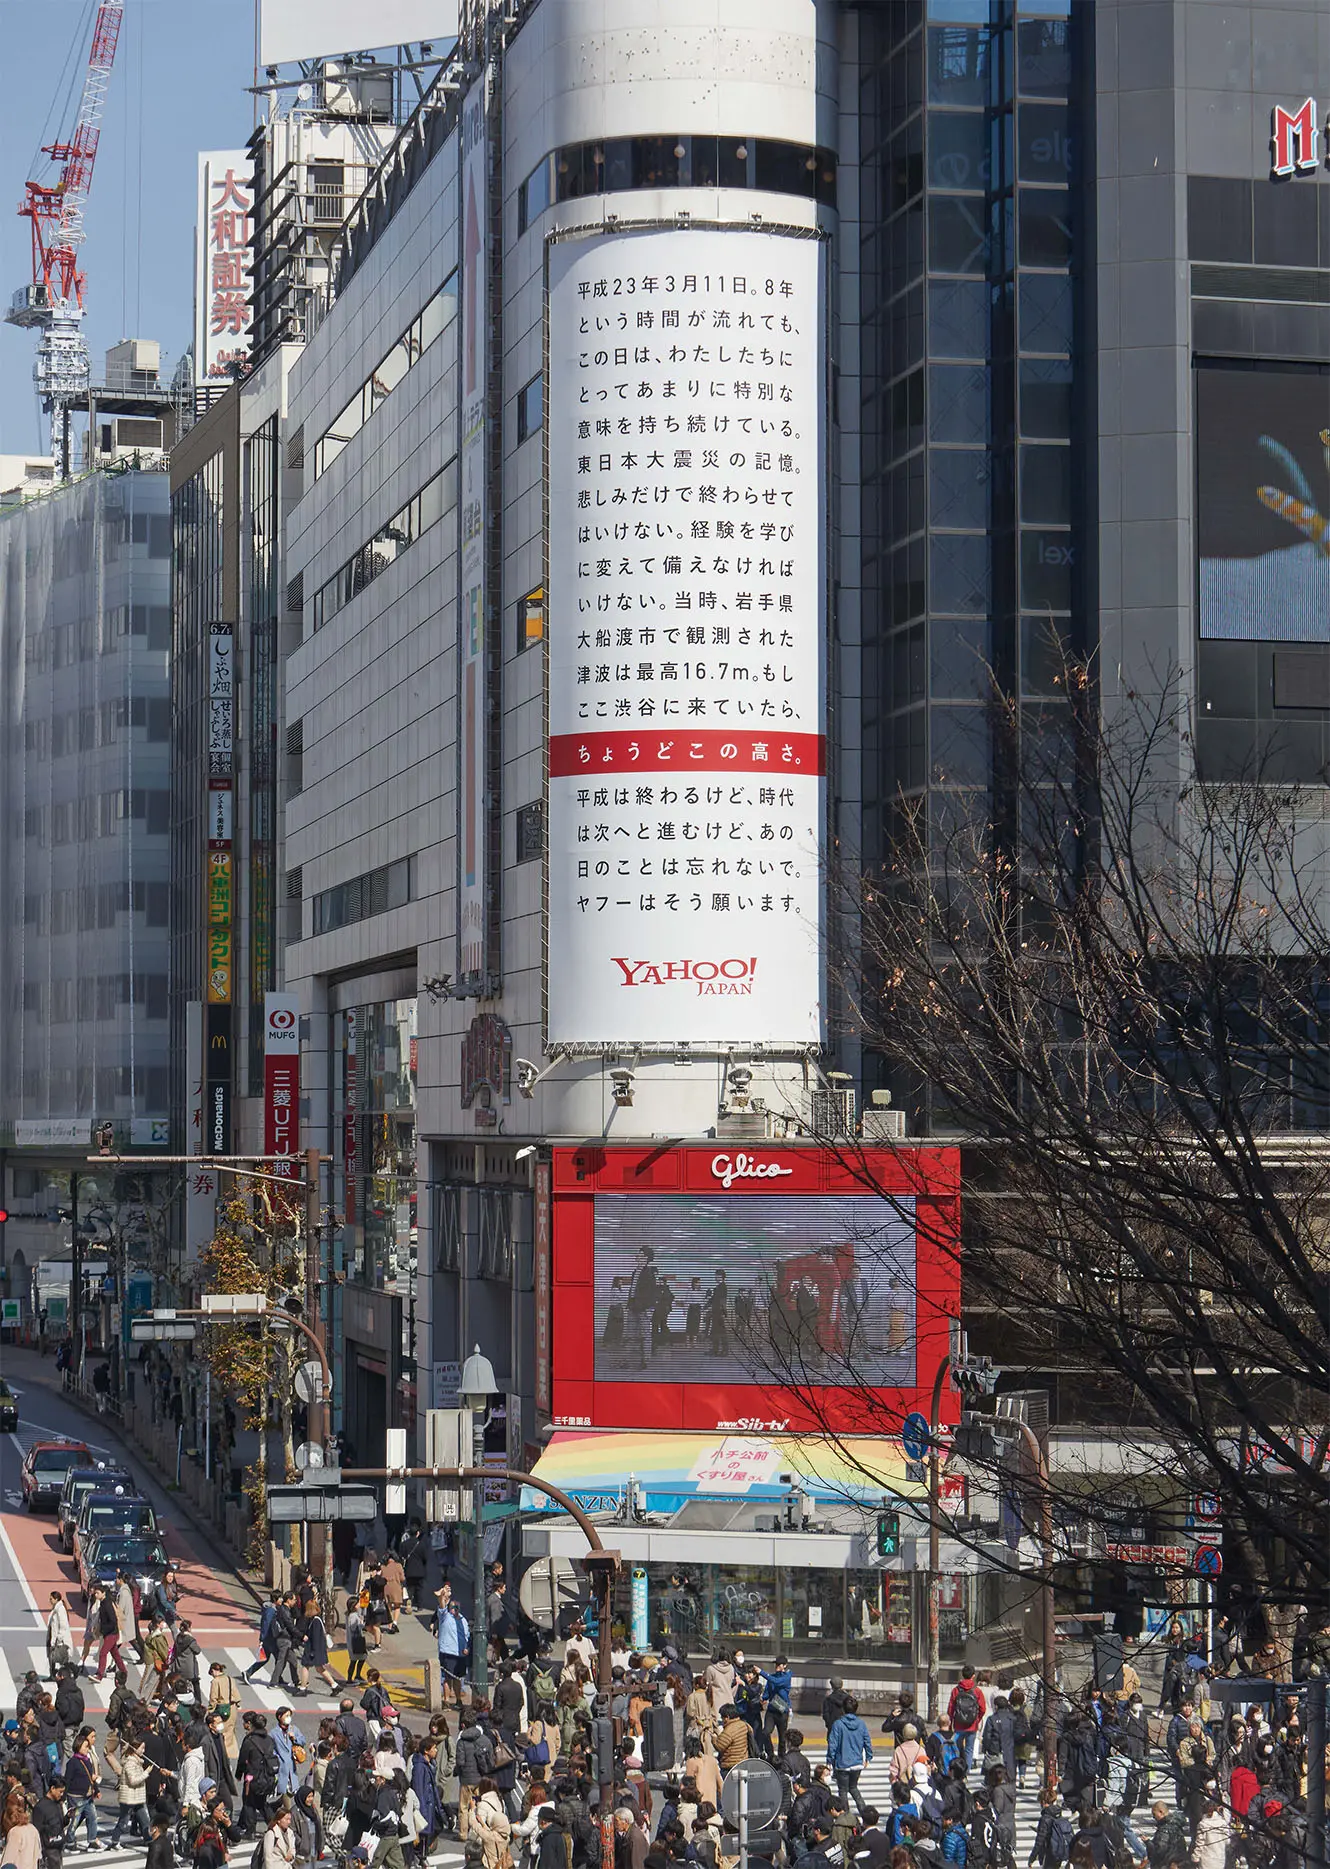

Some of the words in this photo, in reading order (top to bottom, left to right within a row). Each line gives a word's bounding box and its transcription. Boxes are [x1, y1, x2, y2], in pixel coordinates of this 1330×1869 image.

[211, 168, 250, 335] 大和証券
[578, 275, 794, 300] 平成23年3月11日。8年
[579, 310, 800, 335] という時間が流れても、
[579, 345, 793, 368] この日は、わたしたちに
[580, 380, 793, 403] とってあまりに特別な
[578, 414, 801, 440] 意味を持ち続けている。
[578, 450, 801, 474] 東日本大震災の記憶。
[578, 485, 794, 508] 悲しみだけで終わらせて
[579, 520, 794, 543] はいけない。経験を学び
[579, 556, 794, 578] に変えて備えなければ
[579, 591, 793, 613] いけない。当時、岩手県
[578, 626, 794, 649] 大船渡市で観測された
[578, 662, 794, 685] 津波は最高16.7m。もし
[578, 697, 801, 720] ここ渋谷に来ていたら、
[210, 700, 221, 749] しゃぶしゃぶ
[221, 700, 232, 749] せいろ蒸し
[578, 742, 801, 765] ちょうどこの高さ。
[577, 787, 794, 807] 平成は終わるけど、時代
[577, 822, 794, 842] は次へと進むけど、あの
[213, 854, 227, 864] 4F
[578, 857, 801, 879] 日のことは忘れないで。
[577, 893, 801, 914] ヤフーはそう願います。
[610, 957, 758, 987] YAHOO!
[697, 981, 754, 997] JAPAN
[268, 1031, 296, 1040] MUFG
[273, 1070, 291, 1196] 三菱UFJ銀
[711, 1153, 793, 1188] Glico
[711, 1449, 769, 1461] ハチ公前
[727, 1461, 741, 1469] の
[696, 1470, 765, 1482] くすり屋さん
